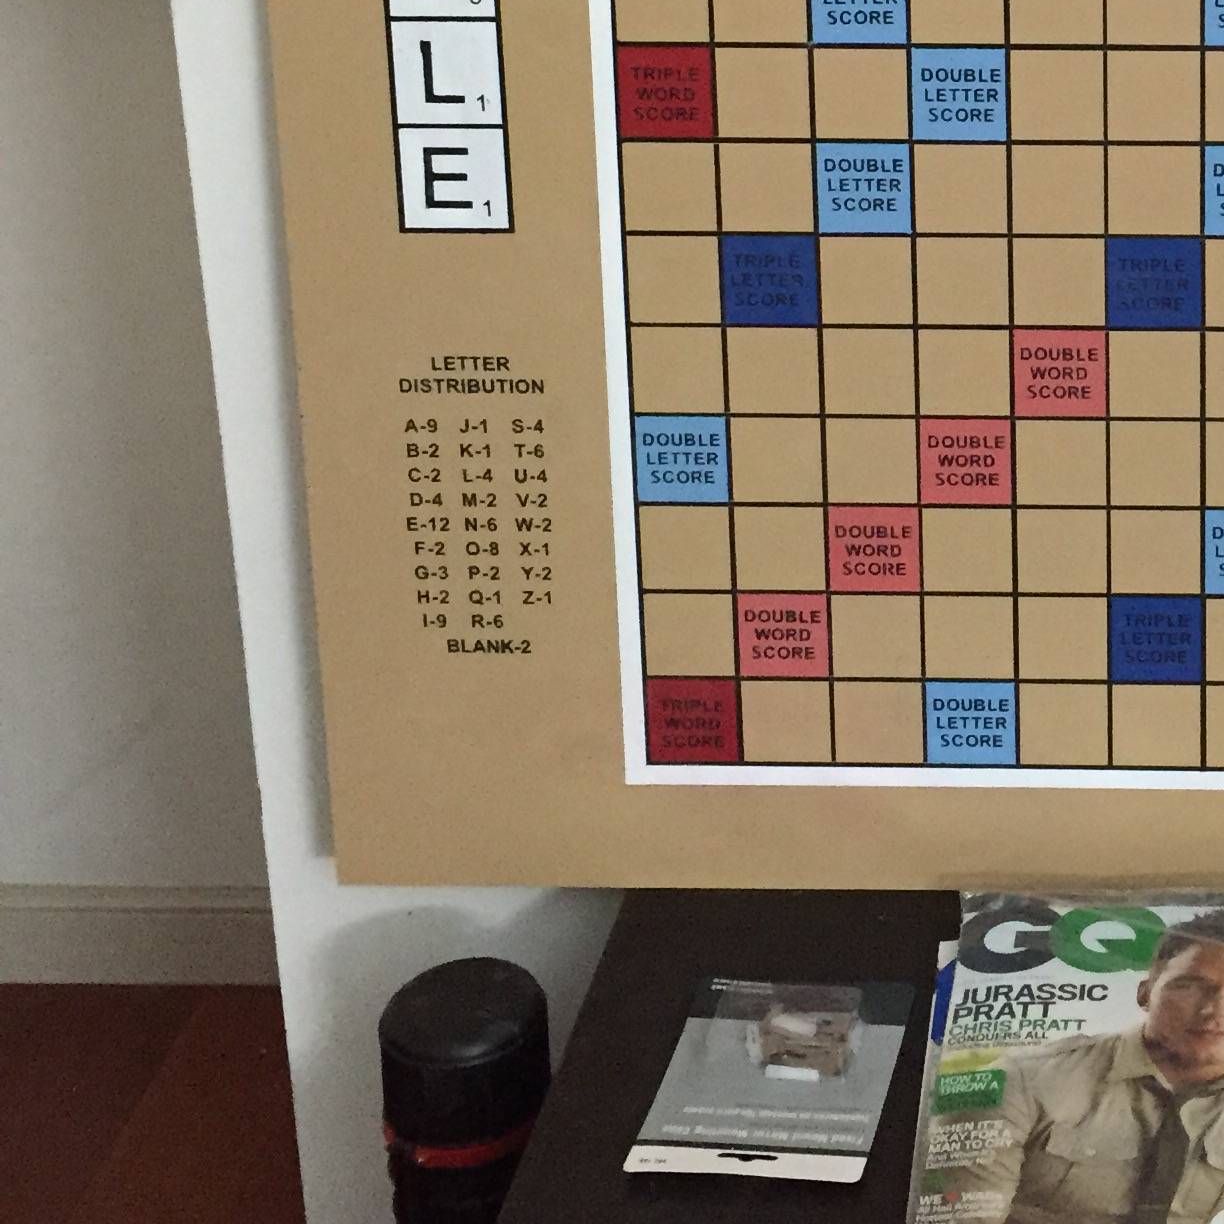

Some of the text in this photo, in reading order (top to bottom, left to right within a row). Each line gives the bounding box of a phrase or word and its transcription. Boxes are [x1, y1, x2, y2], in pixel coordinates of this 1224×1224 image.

[826, 10, 894, 26] SCORE
[431, 356, 510, 371] LETTER
[399, 378, 544, 394] DISTRIBUTION
[404, 419, 544, 434] A-9 J-1 S-4
[406, 443, 544, 458] B-2 K-1 T-6
[408, 467, 547, 484] C-2 L-4 U-4
[409, 492, 547, 508] D-4 M-2 V-2
[406, 517, 552, 532] E-12 N-6 W-2
[834, 524, 911, 539] DOUBLE
[414, 541, 549, 556] F-2 O-8 X-1
[844, 543, 902, 557] WORD
[414, 565, 552, 581] G-3 P-2 Y-2
[842, 561, 906, 576] SCORE
[417, 589, 551, 605] H-2 Q-1 Z-1
[423, 613, 504, 629] I-9 R-6
[447, 639, 532, 654] BLANK-2
[932, 697, 1009, 712] DOUBLE
[936, 716, 1007, 730] LETTER
[940, 733, 1003, 748] SCORE
[957, 905, 1167, 974] GQ
[955, 983, 1109, 1007] JURASSIC
[951, 1001, 1057, 1024] PRATT
[949, 1018, 1087, 1037] CHRIS PRATT
[1024, 1030, 1049, 1040] ALL
[940, 1072, 992, 1085] HOW TO
[989, 1080, 999, 1089] A
[927, 1141, 962, 1154] MAN
[964, 1139, 983, 1150] TO
